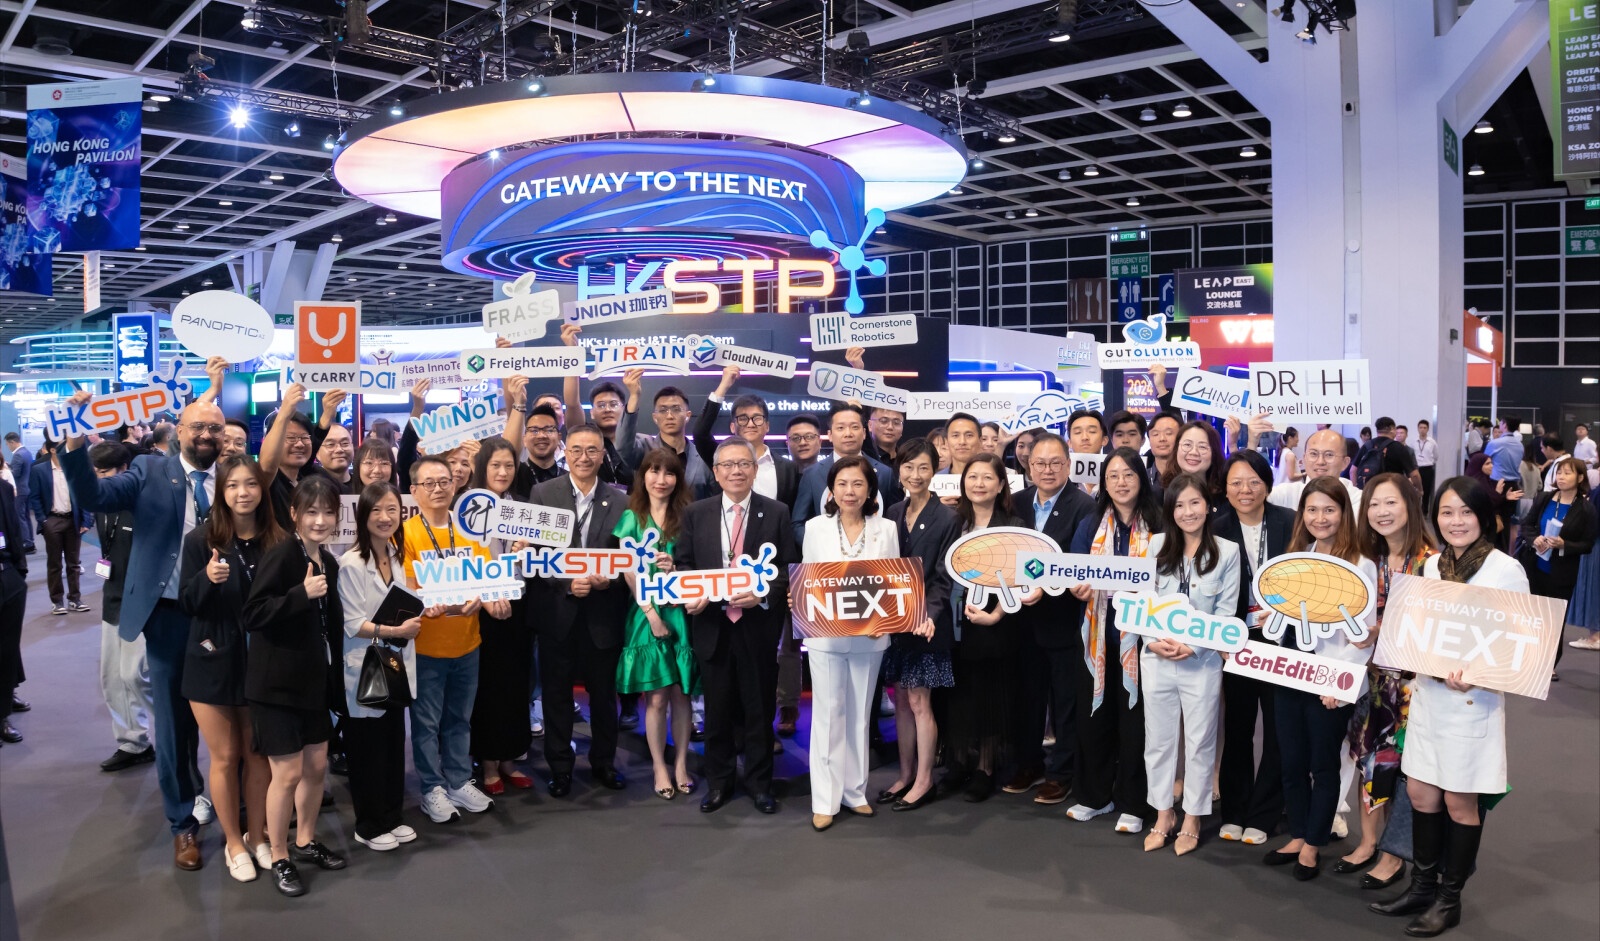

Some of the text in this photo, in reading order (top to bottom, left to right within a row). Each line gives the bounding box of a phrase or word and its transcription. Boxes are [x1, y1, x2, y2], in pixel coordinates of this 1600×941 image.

[1569, 4, 1597, 22] LE
[1565, 35, 1588, 44] LEAP
[1565, 41, 1600, 52] MAIN ST
[1566, 52, 1587, 60] LEAP
[1566, 67, 1600, 76] ORBITA
[1566, 75, 1595, 85] STAGE
[1567, 106, 1594, 115] HONG
[1568, 114, 1592, 123] ZONE
[1568, 123, 1590, 132] 香港區
[33, 137, 110, 156] HONG KONG
[1568, 142, 1600, 151] KSA ZO
[75, 146, 135, 167] PAVILION
[501, 171, 807, 204] GATEWAY TO THE NEXT
[1571, 230, 1600, 238] EMERGEN
[1571, 239, 1598, 251] 緊急
[1112, 257, 1138, 265] EMERGENCY
[1112, 264, 1148, 275] 緊急出口
[1194, 277, 1232, 288] LEAP
[1206, 291, 1242, 299] LOUNGE
[1206, 300, 1242, 309] 交流休息區
[488, 298, 554, 328] FRASS
[181, 315, 259, 338] PANOPTIC
[850, 320, 912, 330] Cornerstone
[851, 332, 895, 342] Robotics
[595, 345, 686, 363] TIRAIN
[1105, 348, 1193, 358] GUTOLUTION
[427, 361, 461, 372] InnoTe
[490, 356, 579, 371] FreightAmigo
[721, 350, 788, 371] CloudNav AI
[300, 372, 355, 383] Y CARRY
[842, 374, 877, 388] ONE
[1256, 370, 1299, 396] DR
[1127, 379, 1154, 396] 2024
[778, 400, 799, 411] the
[801, 400, 830, 411] Next
[924, 398, 1012, 411] PregnaSense
[1258, 402, 1363, 415] be well live well
[50, 390, 167, 437] HKSTP
[500, 505, 570, 530] 聯科集團
[497, 523, 567, 542] CLUSTERTECH
[526, 552, 633, 574] HKSTP
[1050, 564, 1150, 583] FreightAmigo
[640, 572, 751, 600] HKSTP
[804, 573, 911, 588] GATEWAY TO THE
[806, 588, 912, 622] NEXT
[1404, 595, 1544, 630] GATEWAY TO THE
[1396, 612, 1539, 673] NEXT
